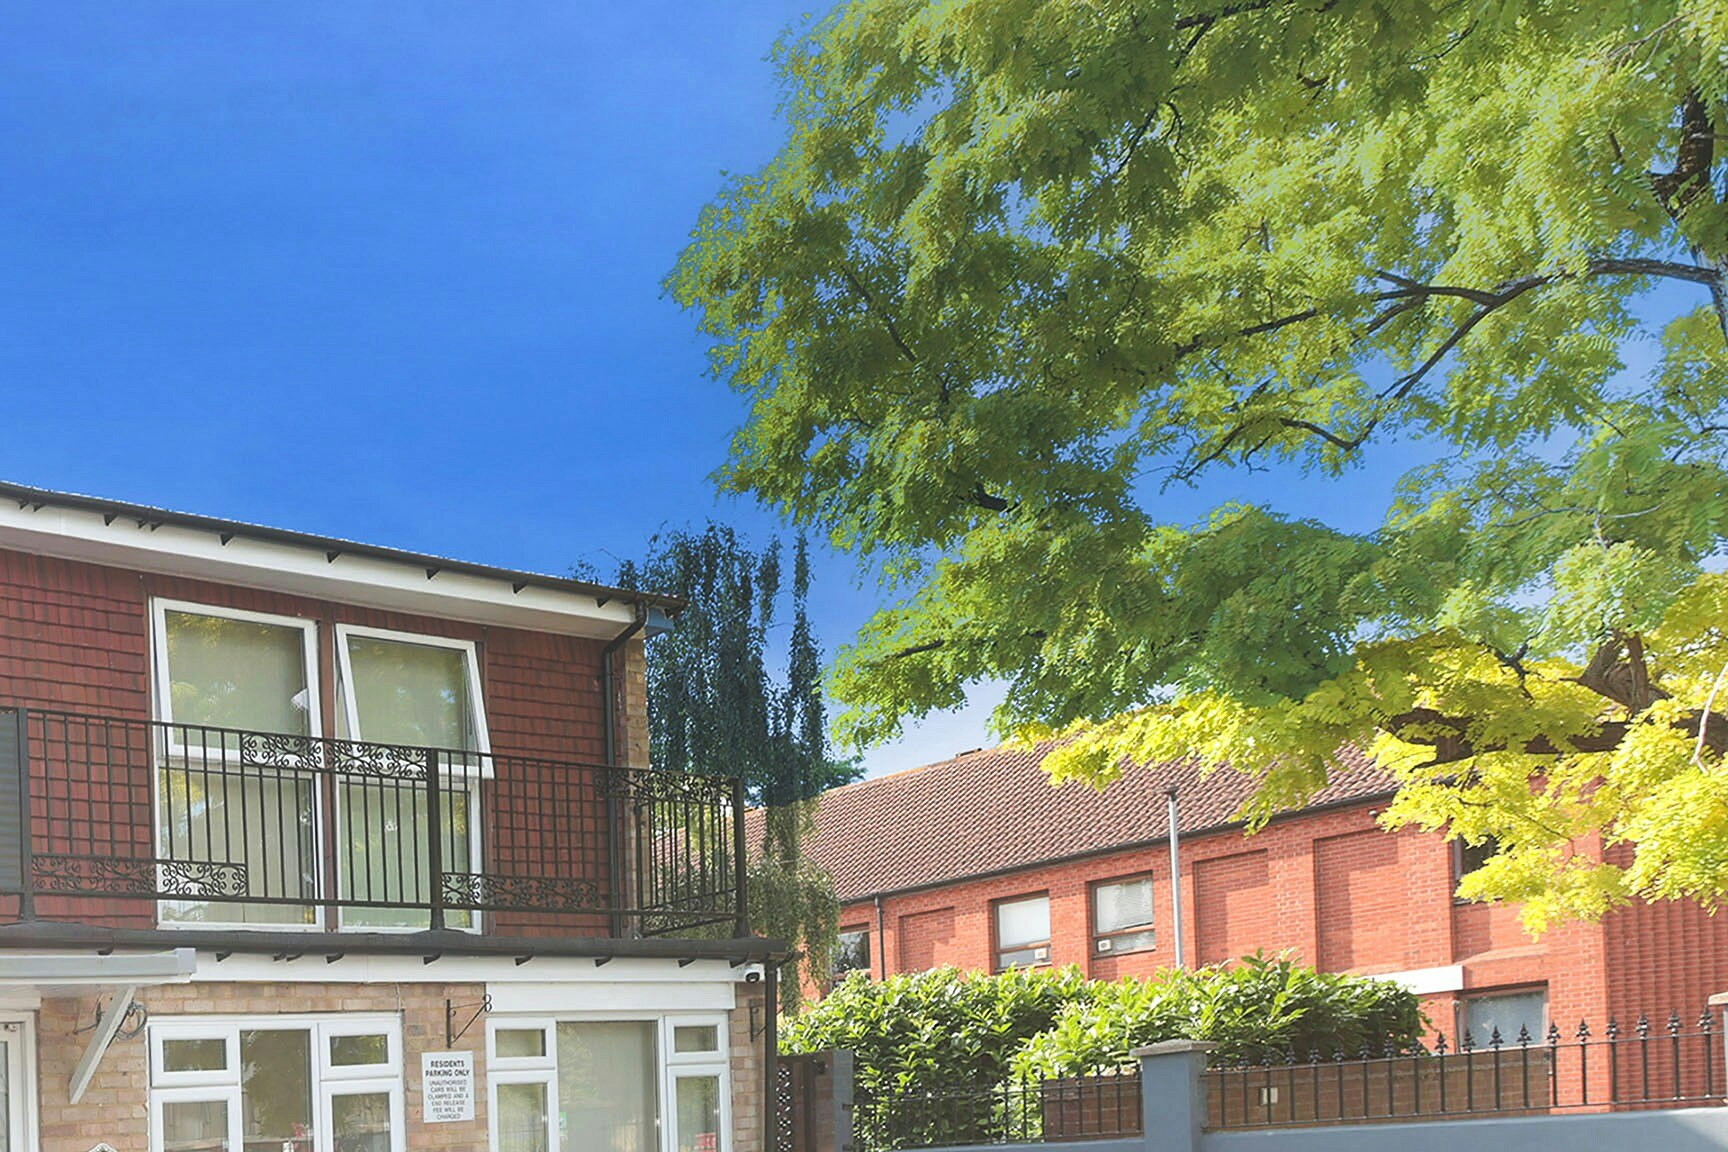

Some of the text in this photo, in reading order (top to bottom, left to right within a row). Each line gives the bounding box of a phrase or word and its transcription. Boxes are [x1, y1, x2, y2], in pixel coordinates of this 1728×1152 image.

[430, 1060, 465, 1068] RESIDENTS
[425, 1068, 470, 1077] PARKING ONLY
